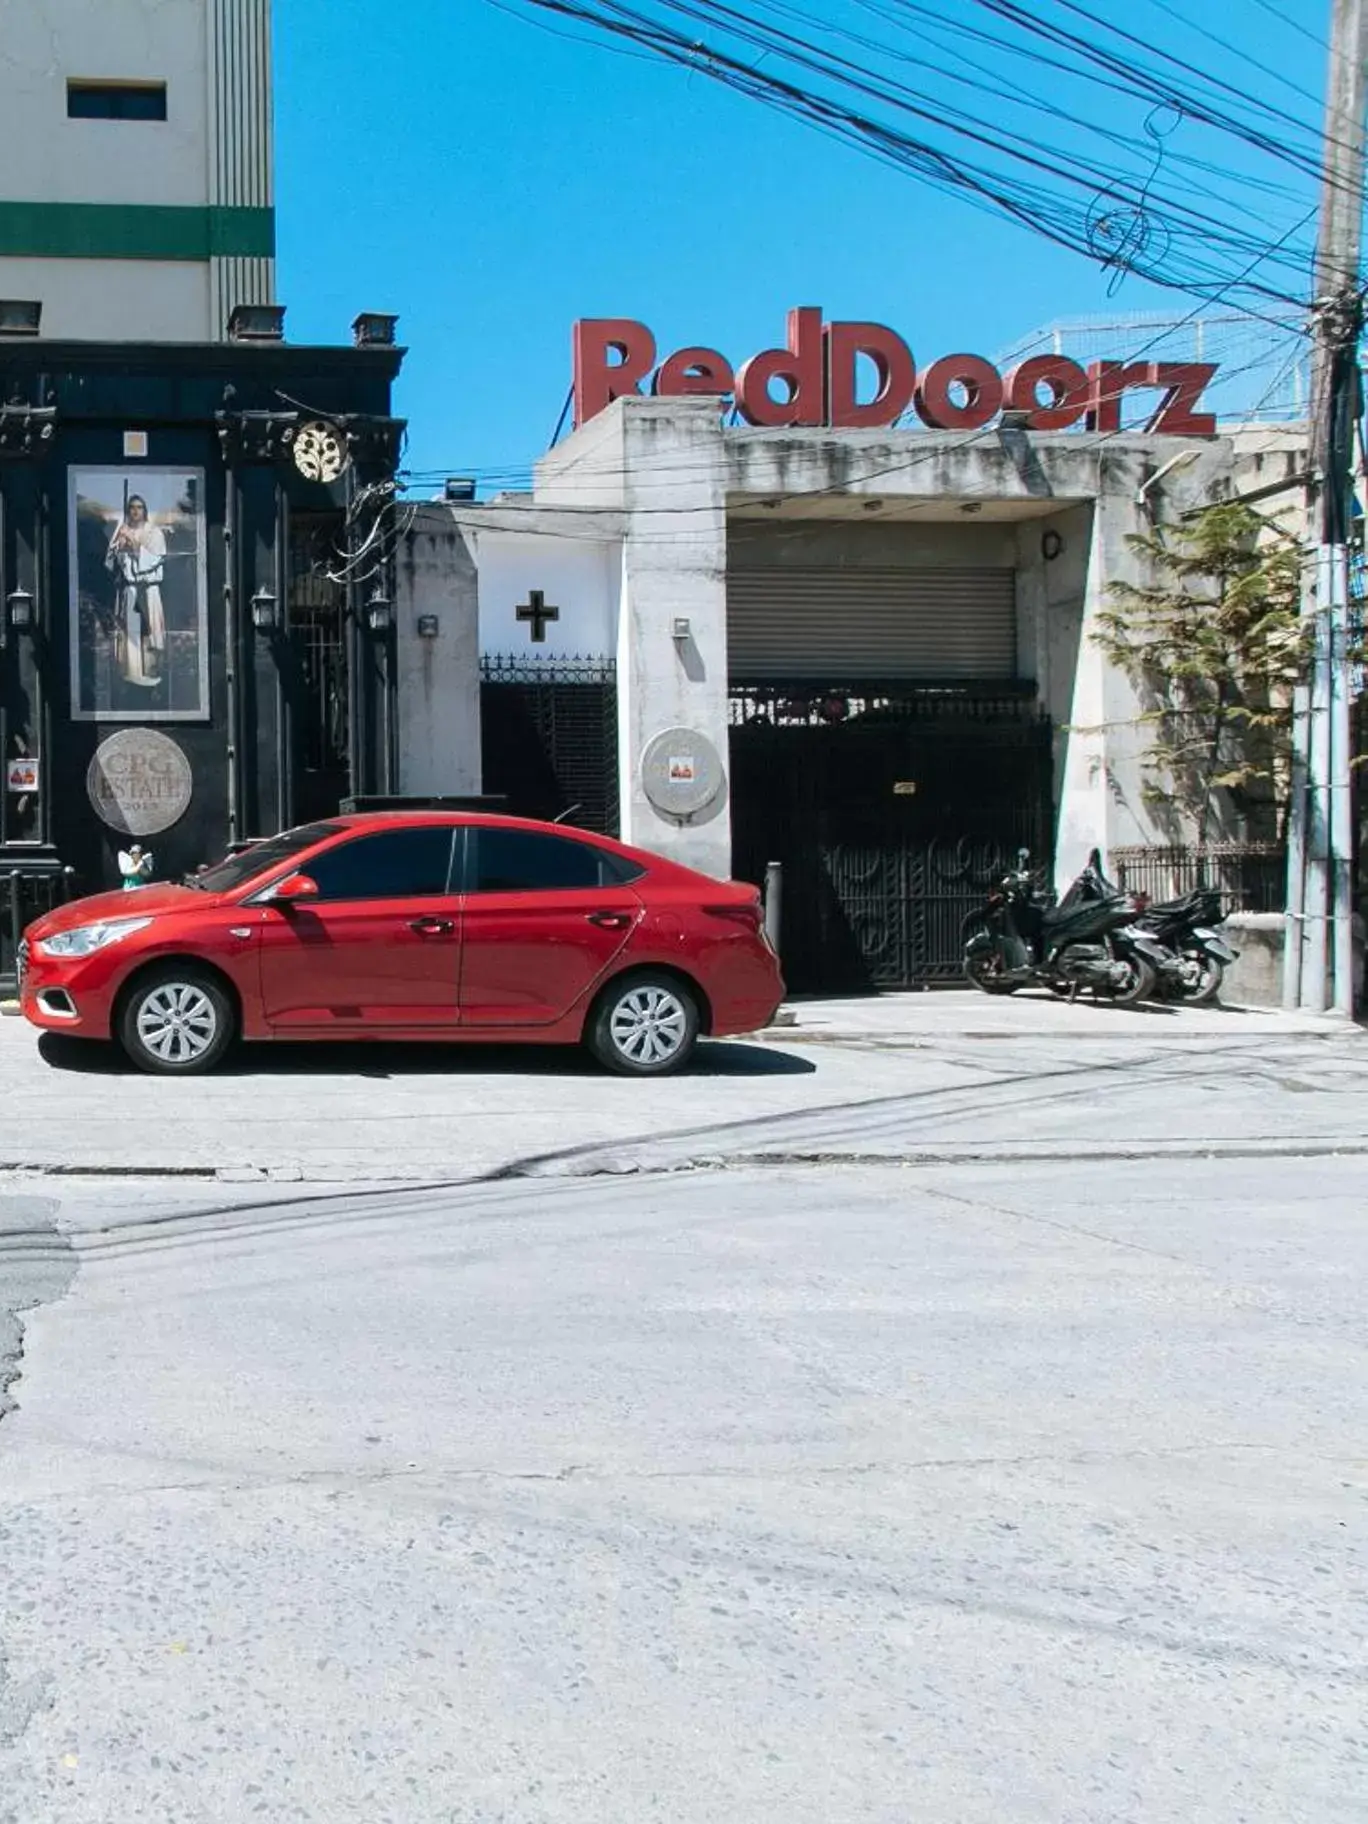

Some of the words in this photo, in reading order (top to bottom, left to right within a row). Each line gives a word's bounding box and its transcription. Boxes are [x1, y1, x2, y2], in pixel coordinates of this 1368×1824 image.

[574, 306, 1220, 435] RedDoorz
[105, 752, 175, 775] CPG
[100, 776, 180, 799] ESTATE
